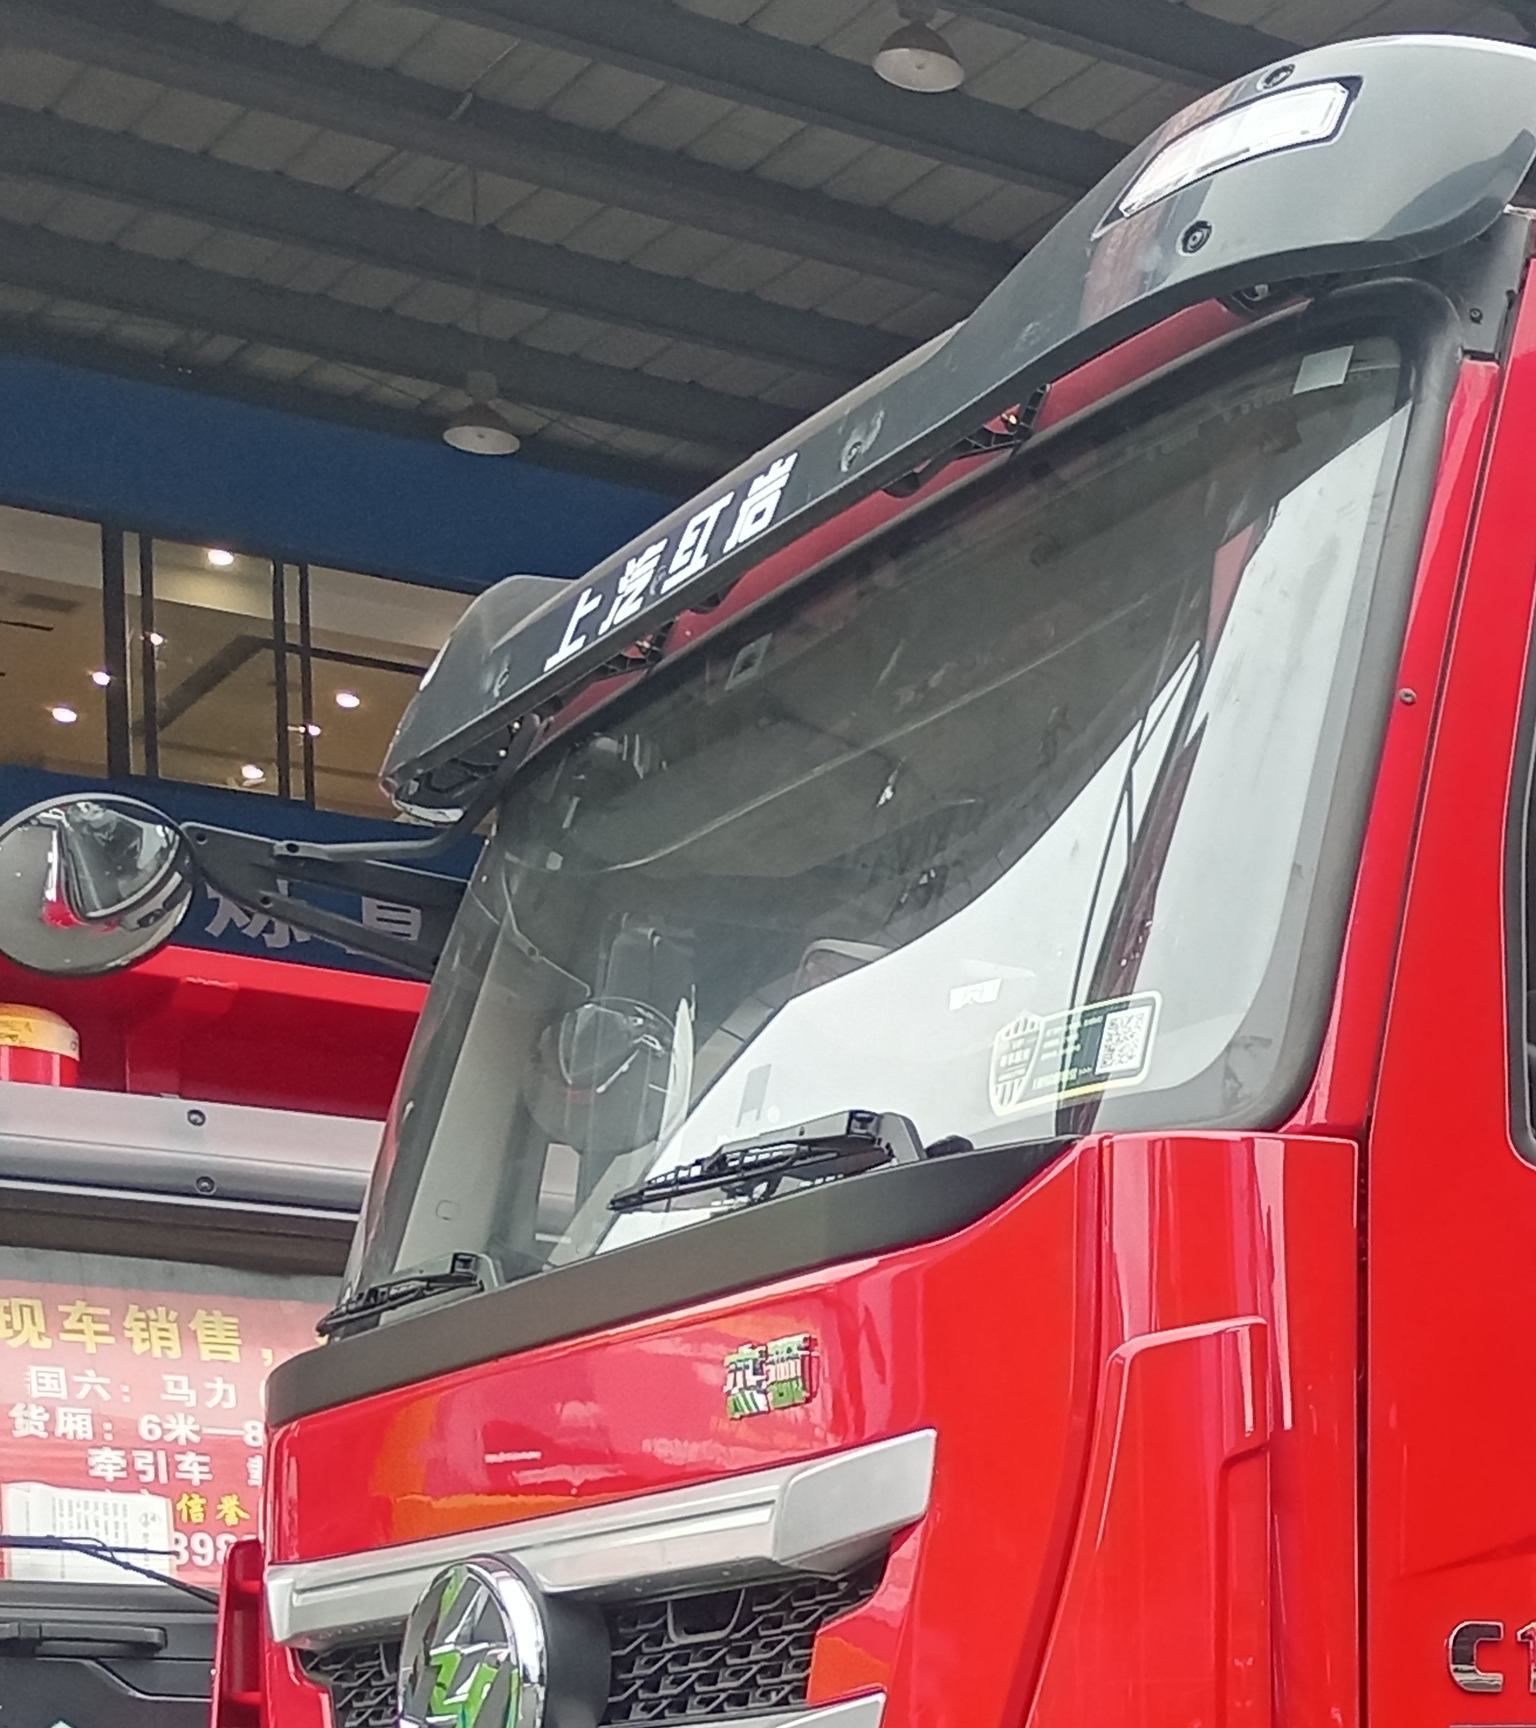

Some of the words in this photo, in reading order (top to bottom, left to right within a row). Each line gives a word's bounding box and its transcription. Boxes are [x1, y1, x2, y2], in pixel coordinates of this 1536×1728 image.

[543, 451, 799, 673] 上汽红岩
[87, 1446, 213, 1486] 牵引车
[176, 1492, 250, 1526] 信誉
